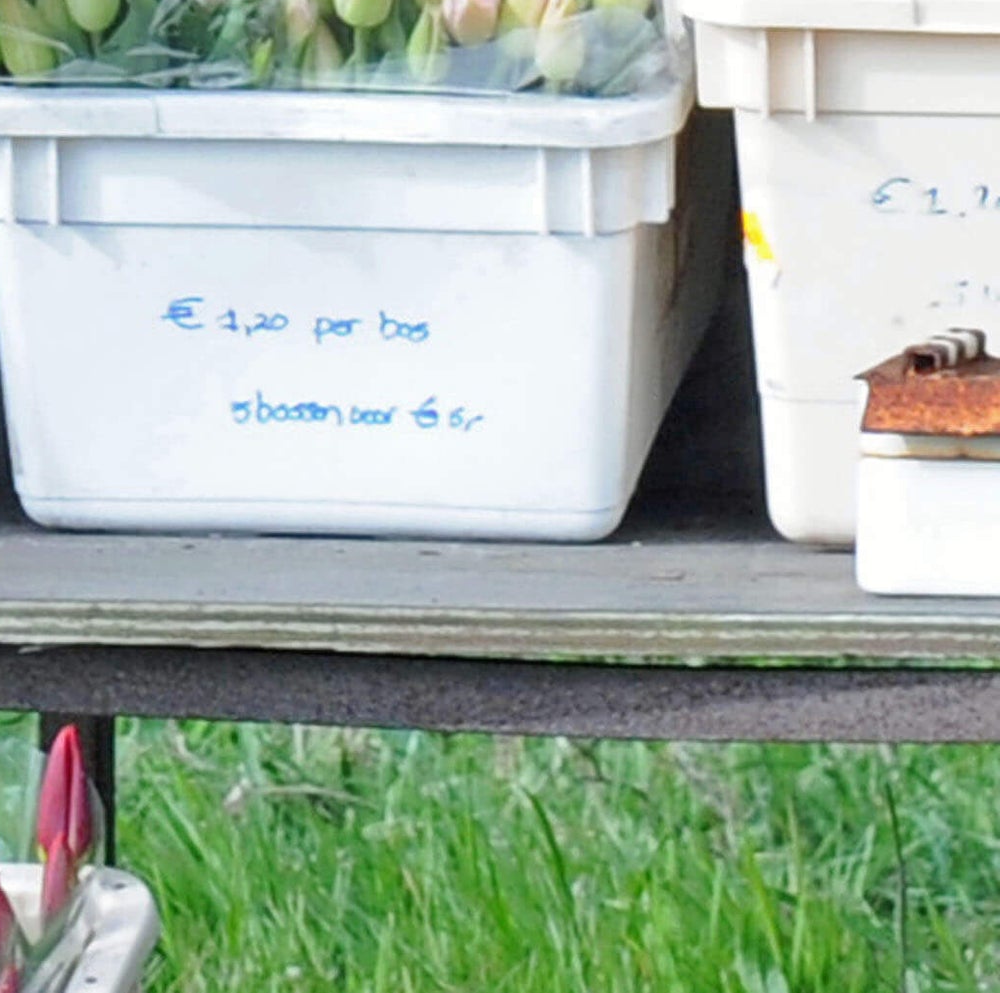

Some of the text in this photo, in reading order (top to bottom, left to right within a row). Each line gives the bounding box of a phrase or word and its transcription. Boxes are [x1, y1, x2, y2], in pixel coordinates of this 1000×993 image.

[161, 296, 431, 345] € 1,20 per bos
